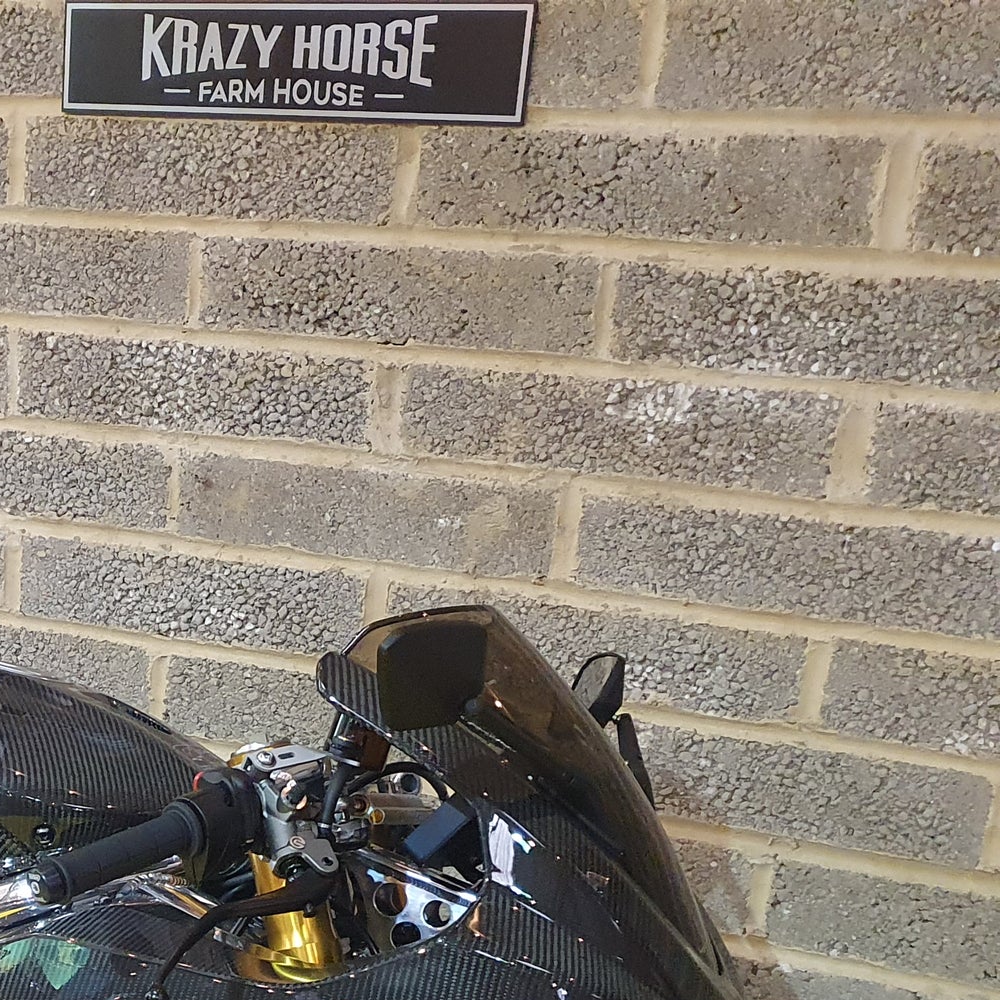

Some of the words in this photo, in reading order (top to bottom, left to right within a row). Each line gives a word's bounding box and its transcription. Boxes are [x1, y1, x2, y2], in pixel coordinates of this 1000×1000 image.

[141, 13, 284, 81] KRAZY
[292, 14, 439, 88] HORSE
[198, 78, 265, 104] FARM
[272, 77, 365, 107] HOUSE
